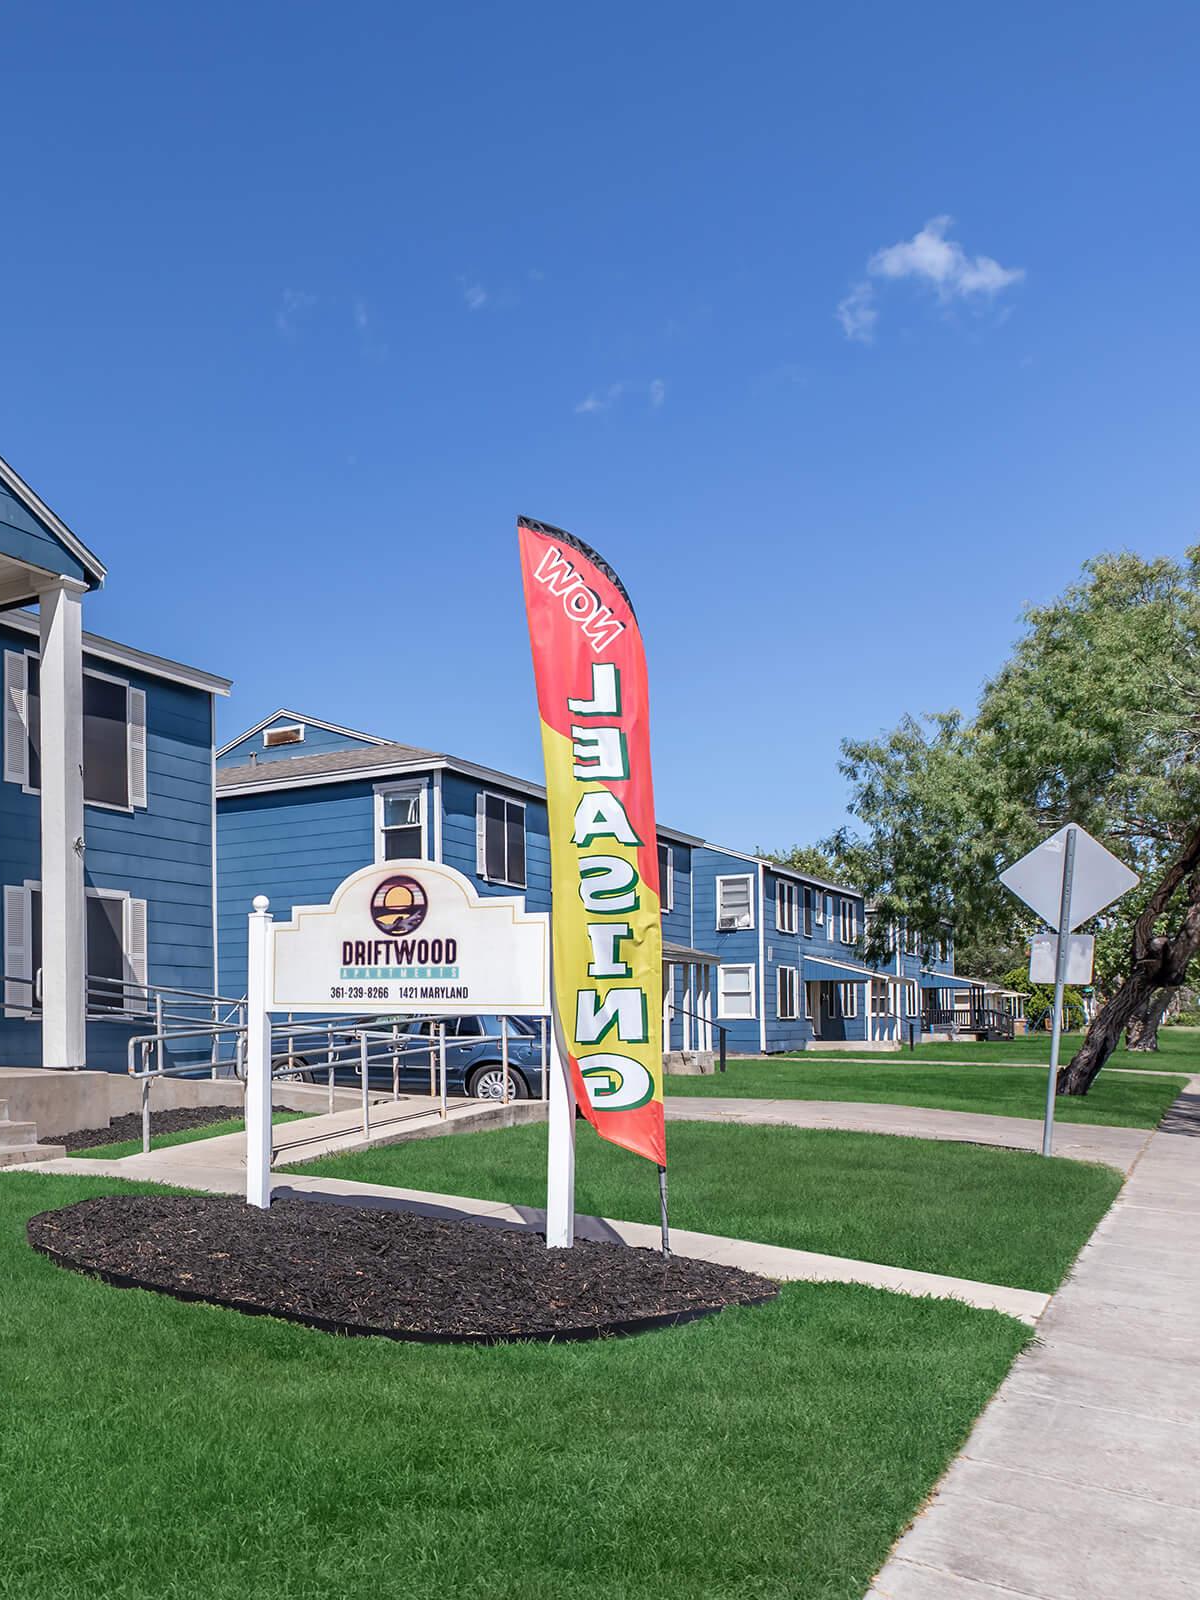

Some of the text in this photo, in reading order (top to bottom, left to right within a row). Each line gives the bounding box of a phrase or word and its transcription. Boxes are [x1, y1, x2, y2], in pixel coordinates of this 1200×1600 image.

[342, 938, 458, 966] DRIFTWOOD
[330, 986, 469, 999] 361-239-8266 1421 MARYLAND
